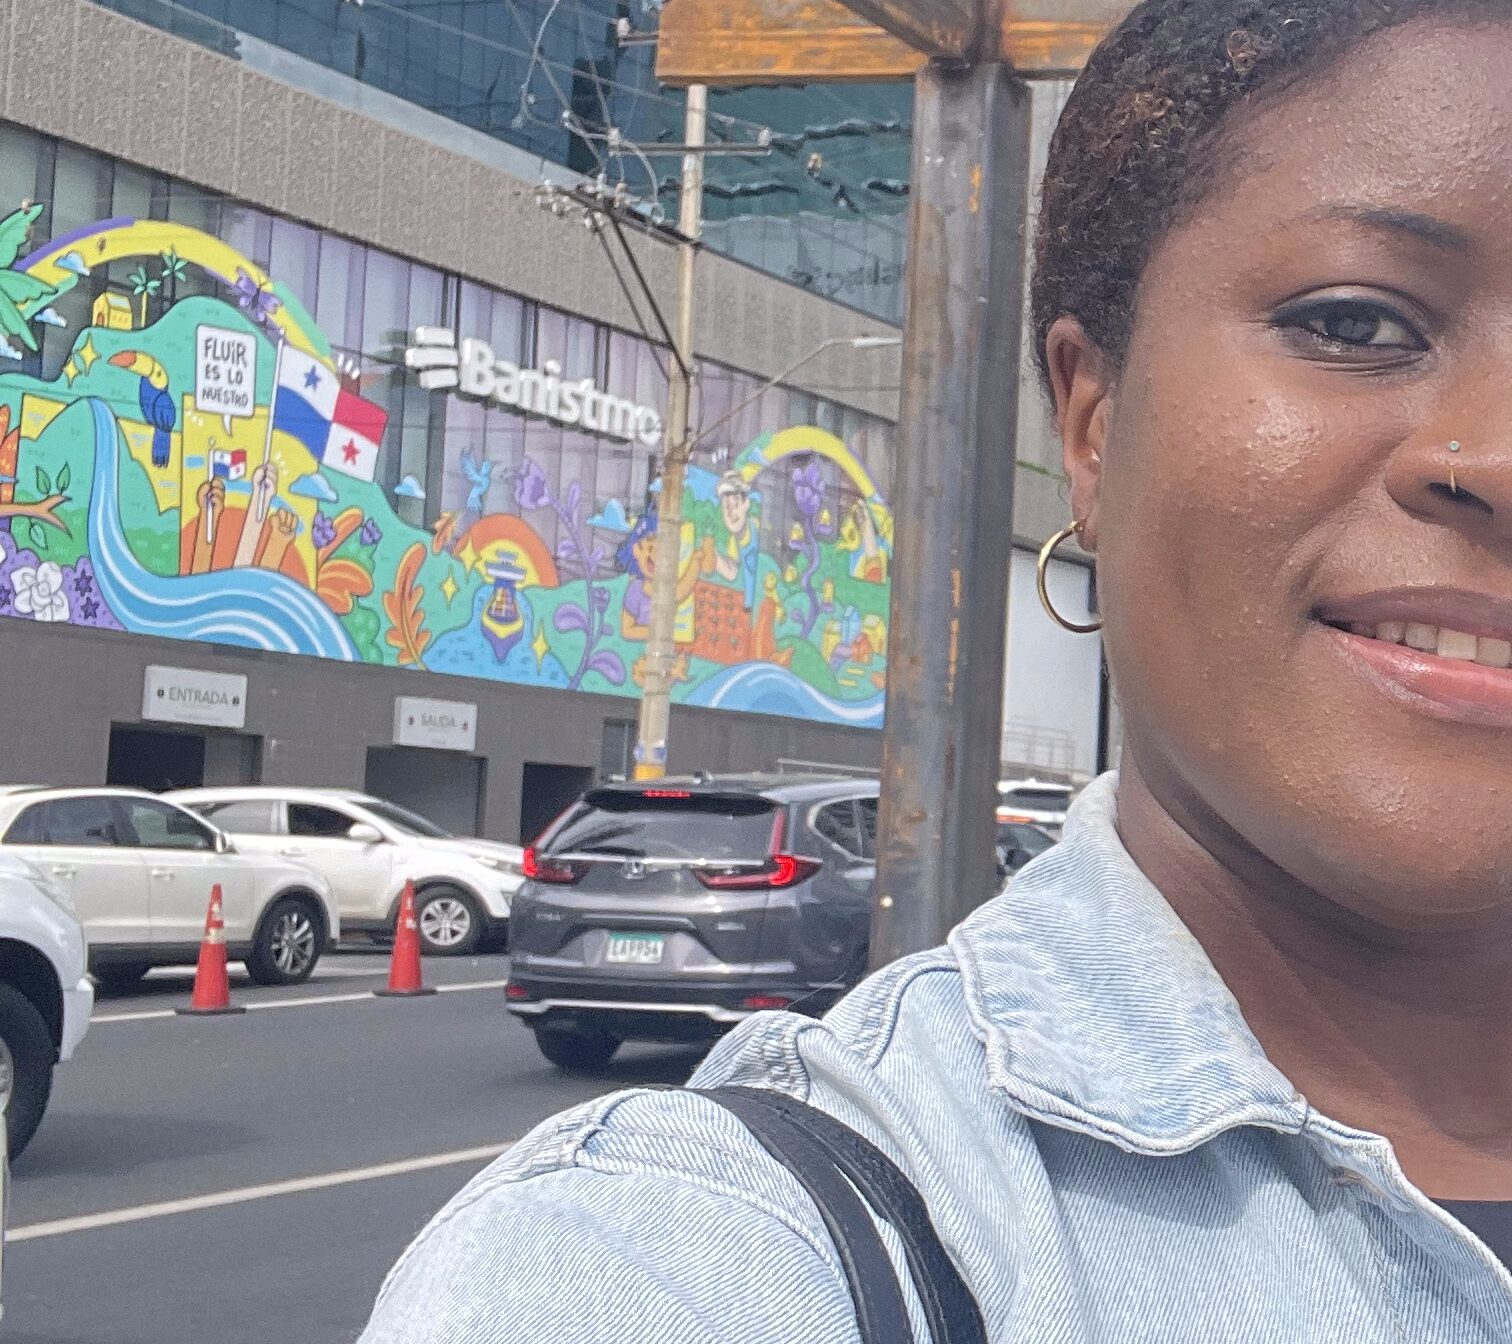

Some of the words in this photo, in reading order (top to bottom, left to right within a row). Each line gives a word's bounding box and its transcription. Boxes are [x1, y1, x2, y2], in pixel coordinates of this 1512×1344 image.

[205, 362, 220, 380] ES
[227, 367, 243, 384] LO
[201, 386, 249, 408] NUESTRO
[168, 687, 229, 705] ENTRADA
